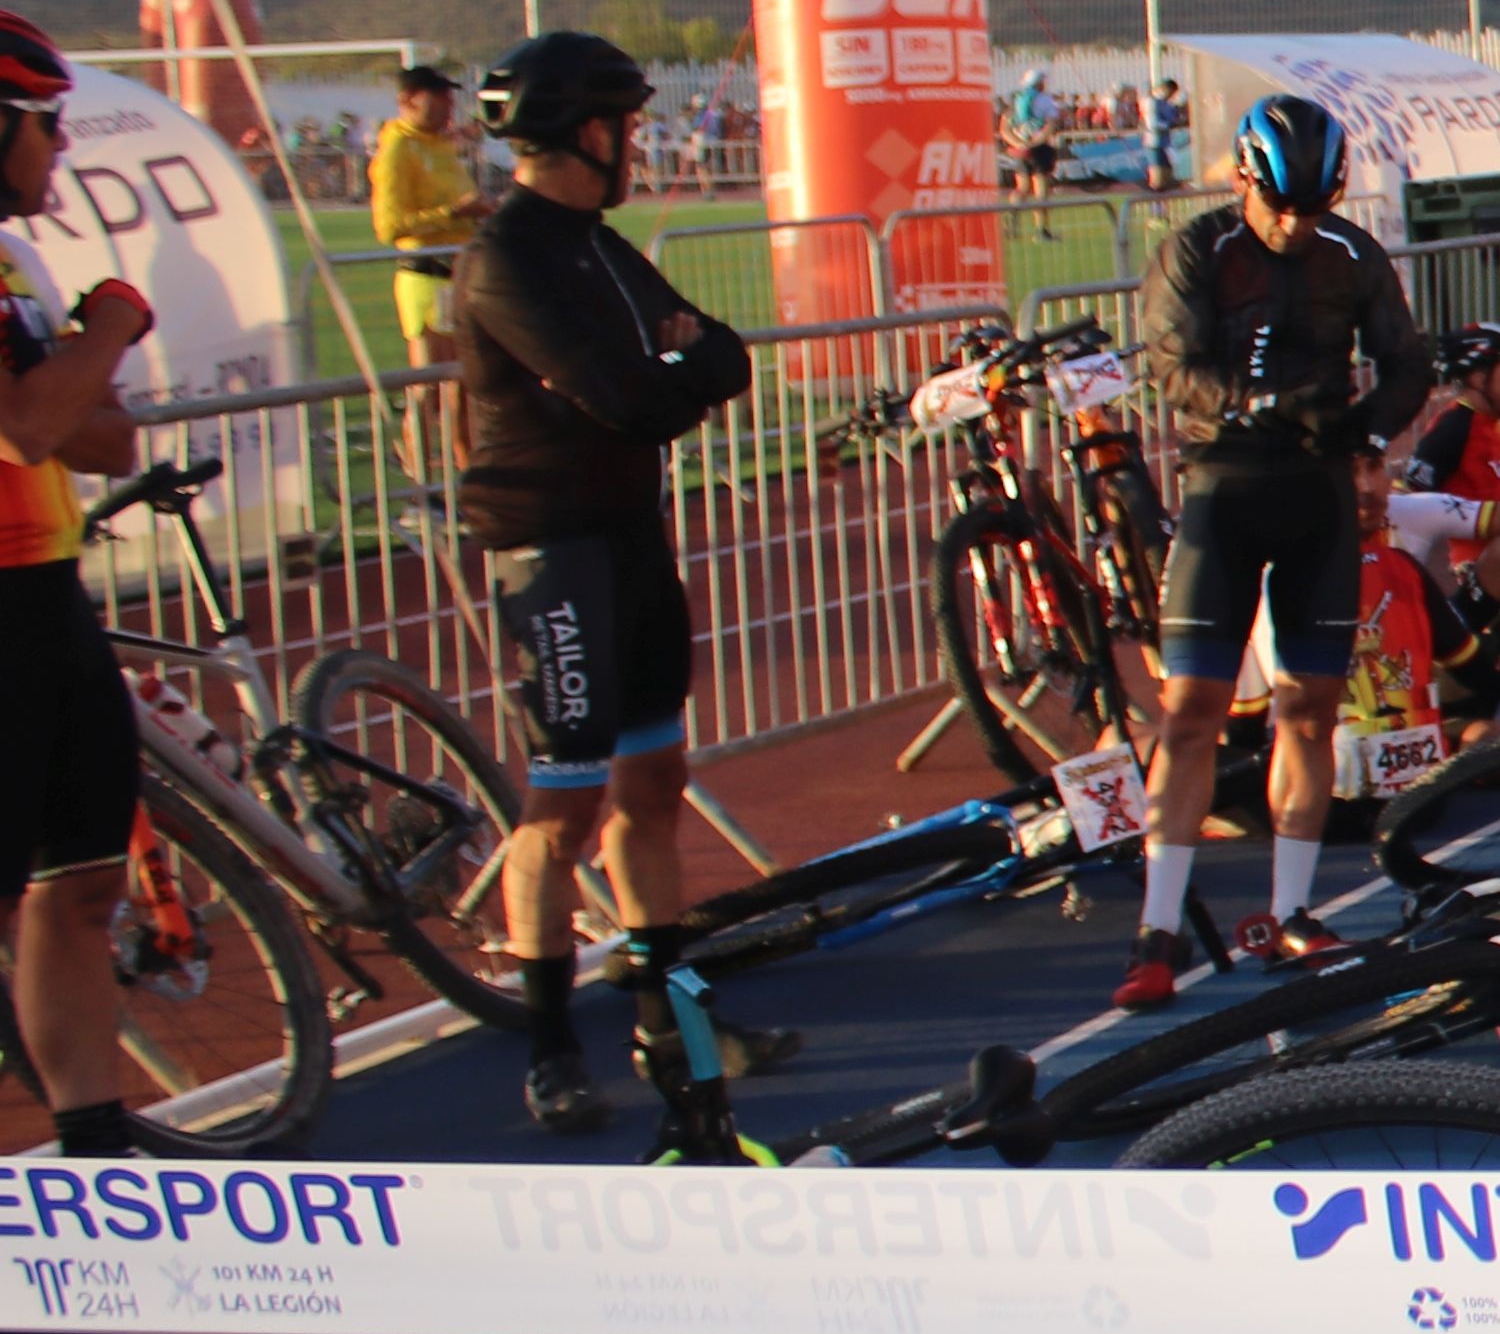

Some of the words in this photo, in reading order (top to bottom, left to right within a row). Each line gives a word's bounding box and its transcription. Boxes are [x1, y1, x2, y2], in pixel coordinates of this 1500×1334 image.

[1376, 739, 1438, 769] 4662
[77, 1260, 131, 1287] KM
[212, 1267, 243, 1281] 101
[246, 1264, 284, 1283] KM
[287, 1269, 316, 1286] 24
[317, 1267, 337, 1283] H
[77, 1291, 141, 1319] 24H
[219, 1294, 252, 1314] LA
[254, 1290, 345, 1316] LEGIÓN
[1461, 1297, 1498, 1310] 100%
